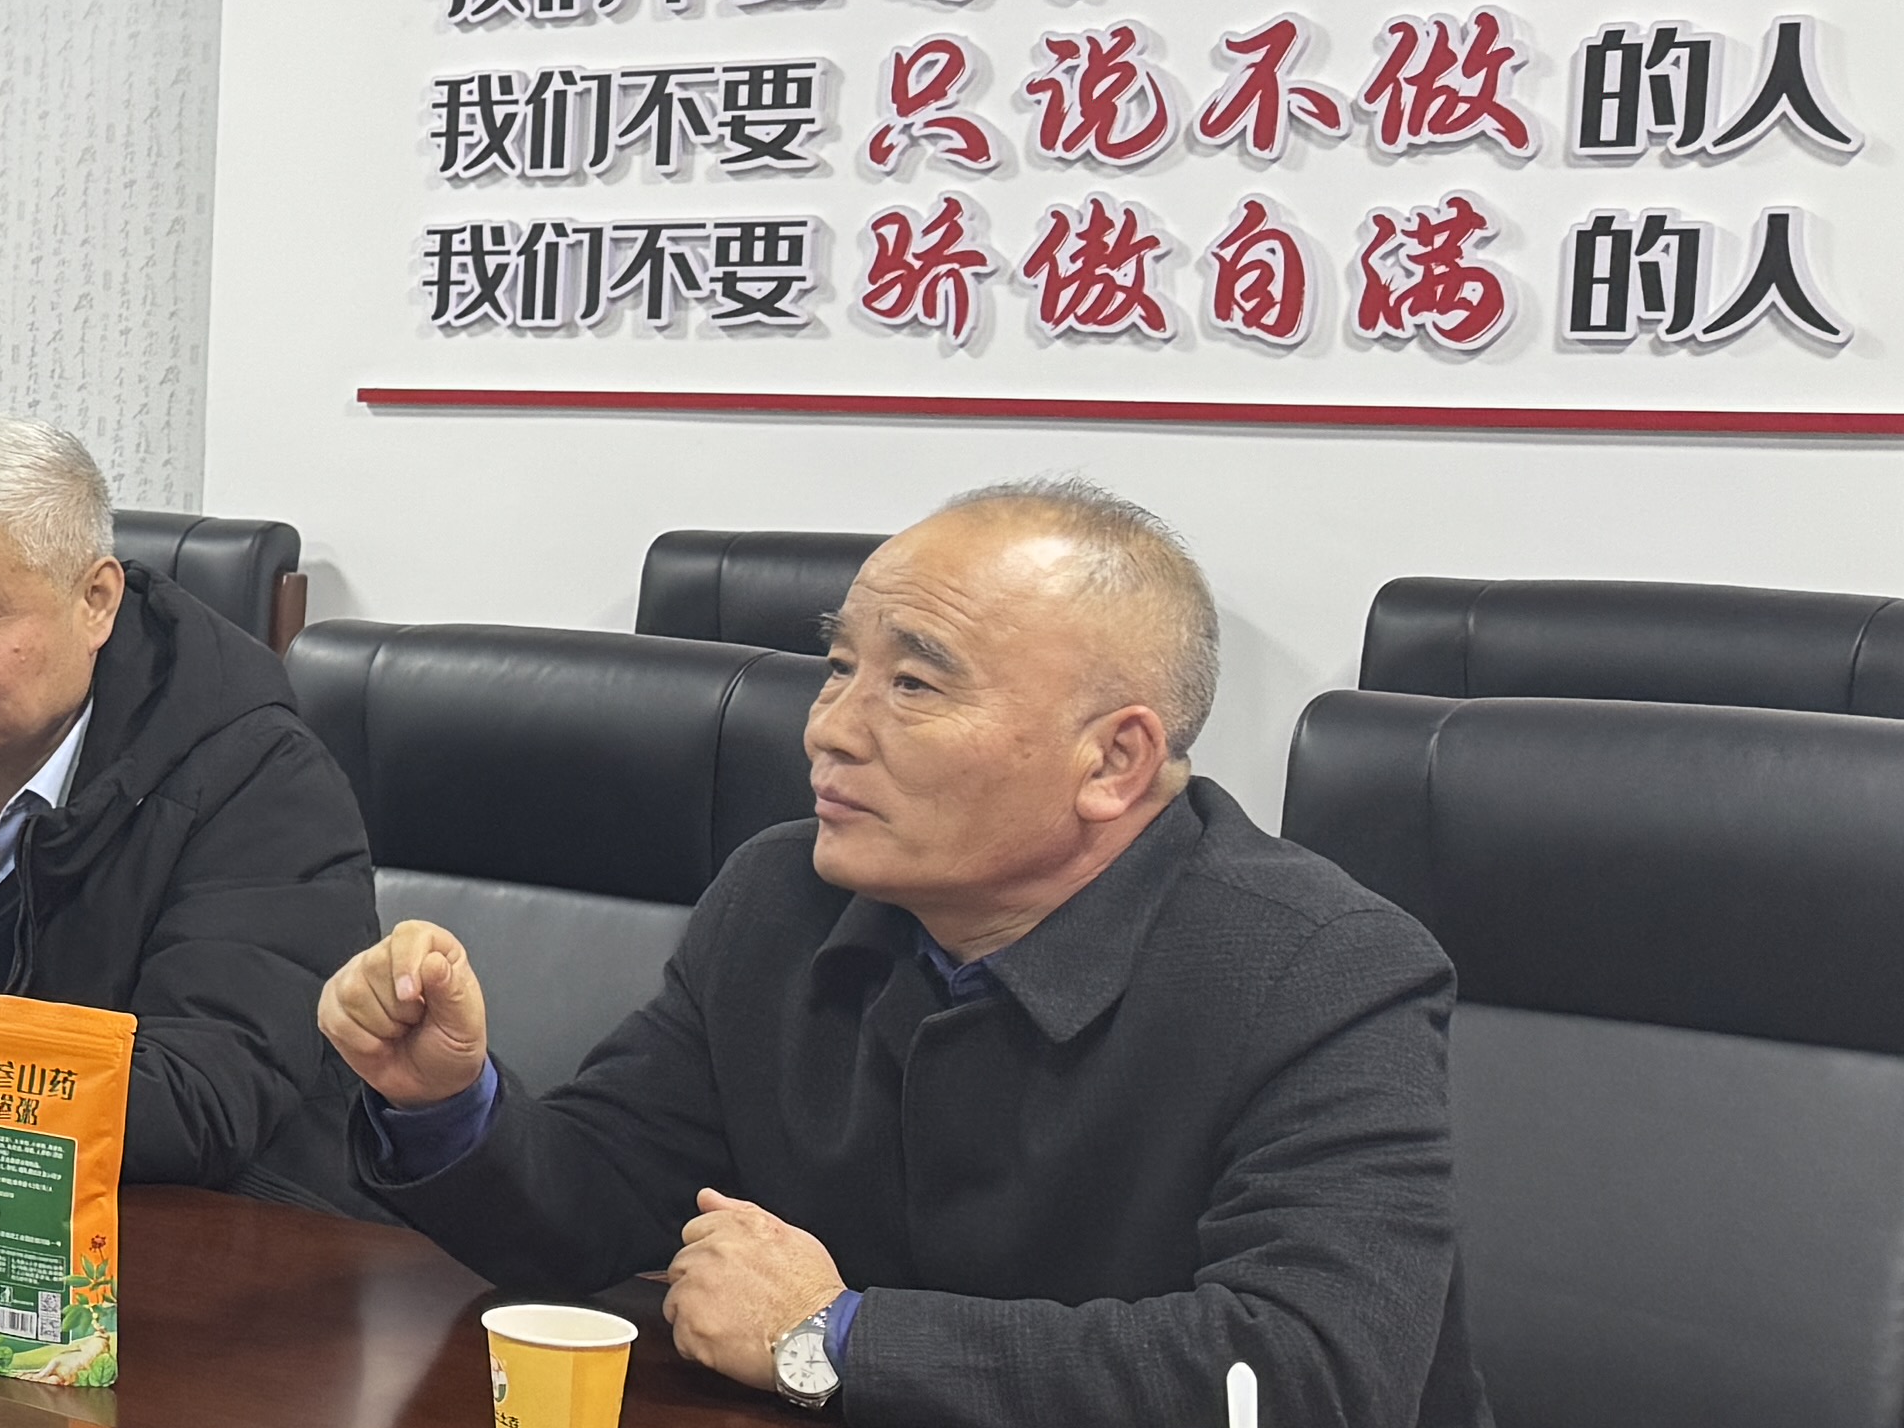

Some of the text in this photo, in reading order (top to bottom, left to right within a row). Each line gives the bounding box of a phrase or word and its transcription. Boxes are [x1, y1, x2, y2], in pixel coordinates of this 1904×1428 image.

[431, 13, 1852, 172] 我们不要只说不做的人
[423, 196, 1841, 342] 我们不要骄傲自满的人
